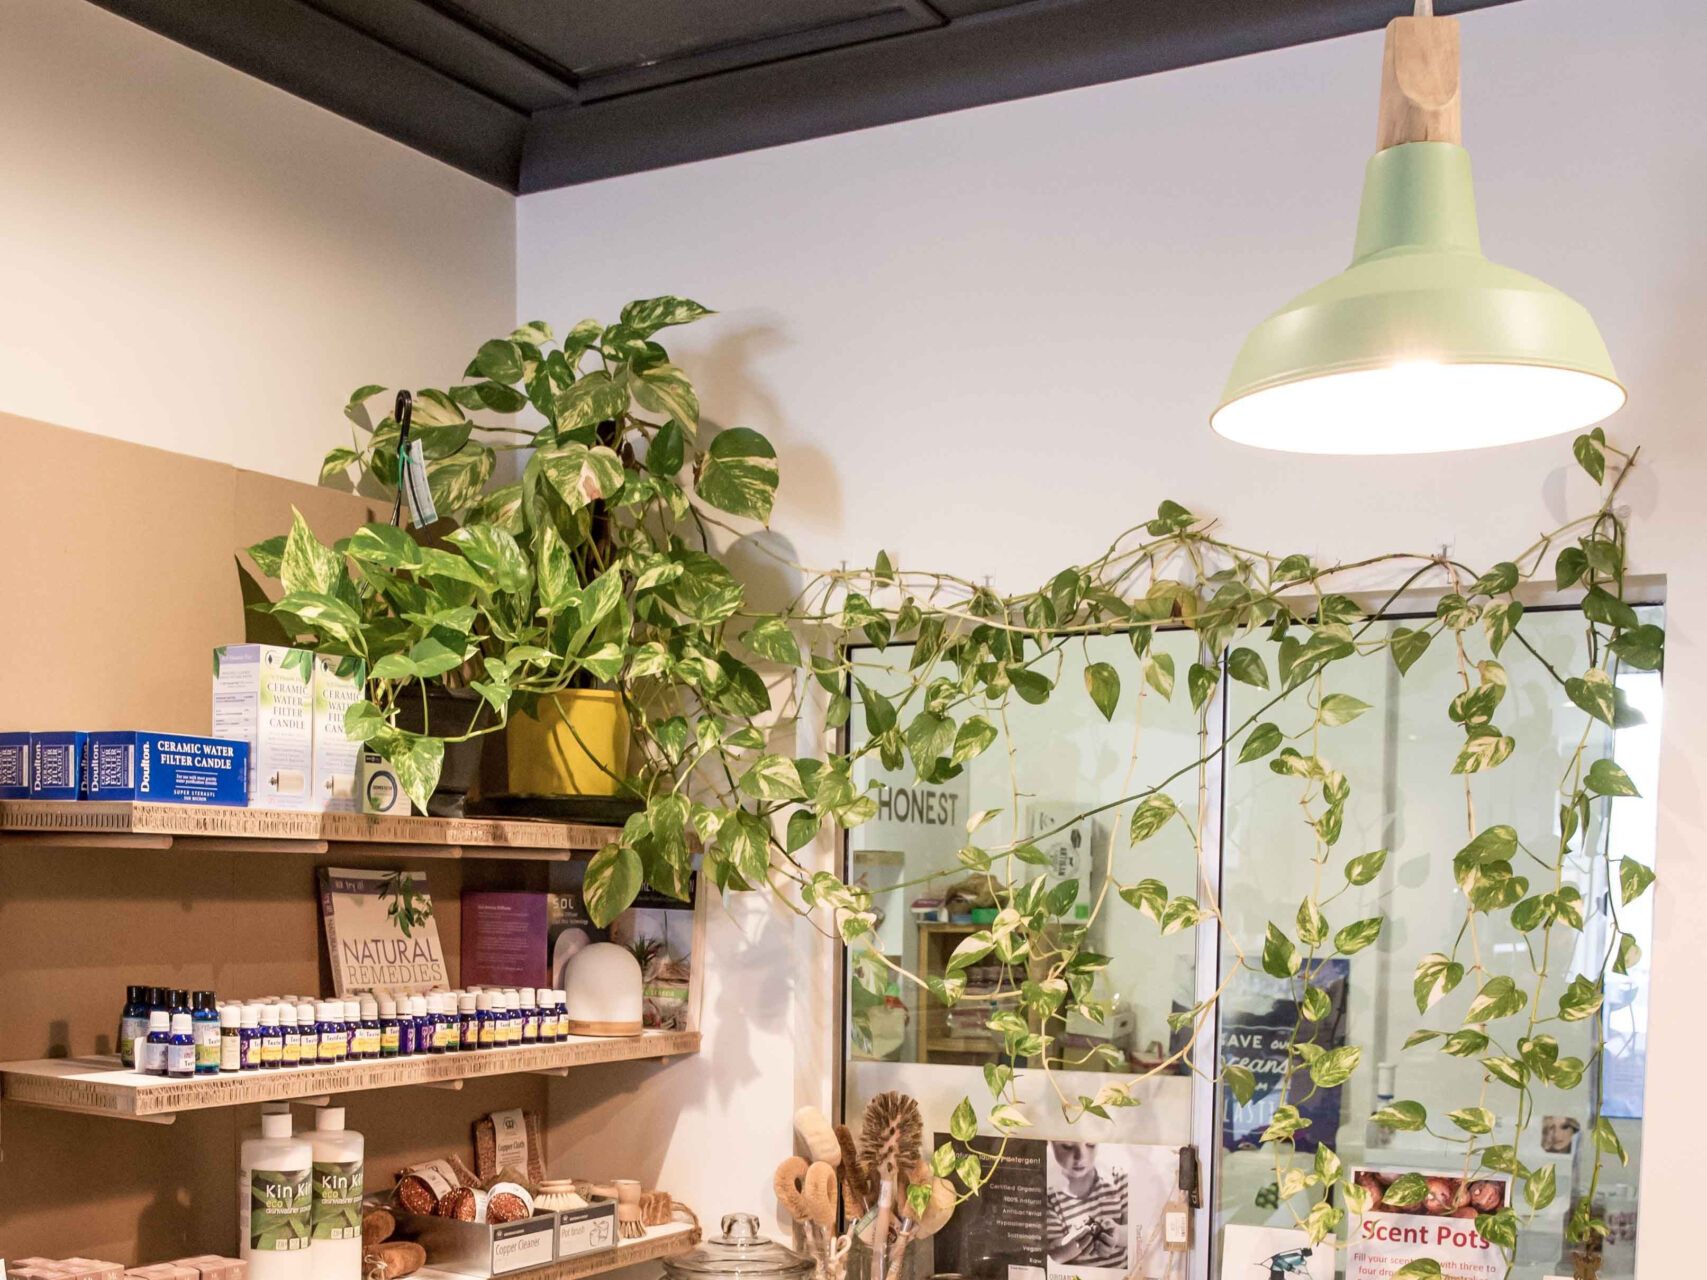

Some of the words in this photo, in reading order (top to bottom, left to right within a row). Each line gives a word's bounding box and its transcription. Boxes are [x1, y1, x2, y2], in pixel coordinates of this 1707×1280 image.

[267, 683, 309, 696] CERAMIC
[323, 689, 361, 700] CERAMIC
[273, 695, 303, 706] WATER
[273, 706, 303, 717] FILTER
[269, 718, 304, 730] CANDLE
[324, 725, 344, 734] CAN
[157, 740, 202, 754] CERAMIC
[203, 744, 234, 757] WATER
[91, 744, 99, 792] Doulton
[141, 743, 150, 793] Doulton
[160, 754, 193, 766] FILTER
[194, 757, 232, 769] CANDLE
[878, 786, 959, 826] HONEST
[342, 938, 439, 965] NATURAL
[346, 963, 443, 985] REMEDIES
[1222, 1056, 1290, 1075] ceans
[498, 1142, 513, 1152] Copper
[1004, 1156, 1041, 1165] detergent
[322, 1175, 348, 1189] Kin
[989, 1183, 1016, 1191] Certified
[266, 1184, 293, 1198] Kin
[321, 1190, 338, 1198] eco
[265, 1200, 283, 1208] eco
[561, 1227, 571, 1238] Pot
[1362, 1219, 1429, 1245] Scent
[1437, 1225, 1491, 1250] Pots
[495, 1242, 517, 1257] Copper
[517, 1236, 541, 1252] Cleaner
[1022, 1245, 1042, 1253] Vegan
[1353, 1252, 1366, 1261] Fill
[1368, 1255, 1387, 1265] your
[1459, 1262, 1484, 1273] three
[1486, 1264, 1496, 1273] to
[1358, 1265, 1377, 1275] four
[1378, 1267, 1394, 1276] dro
